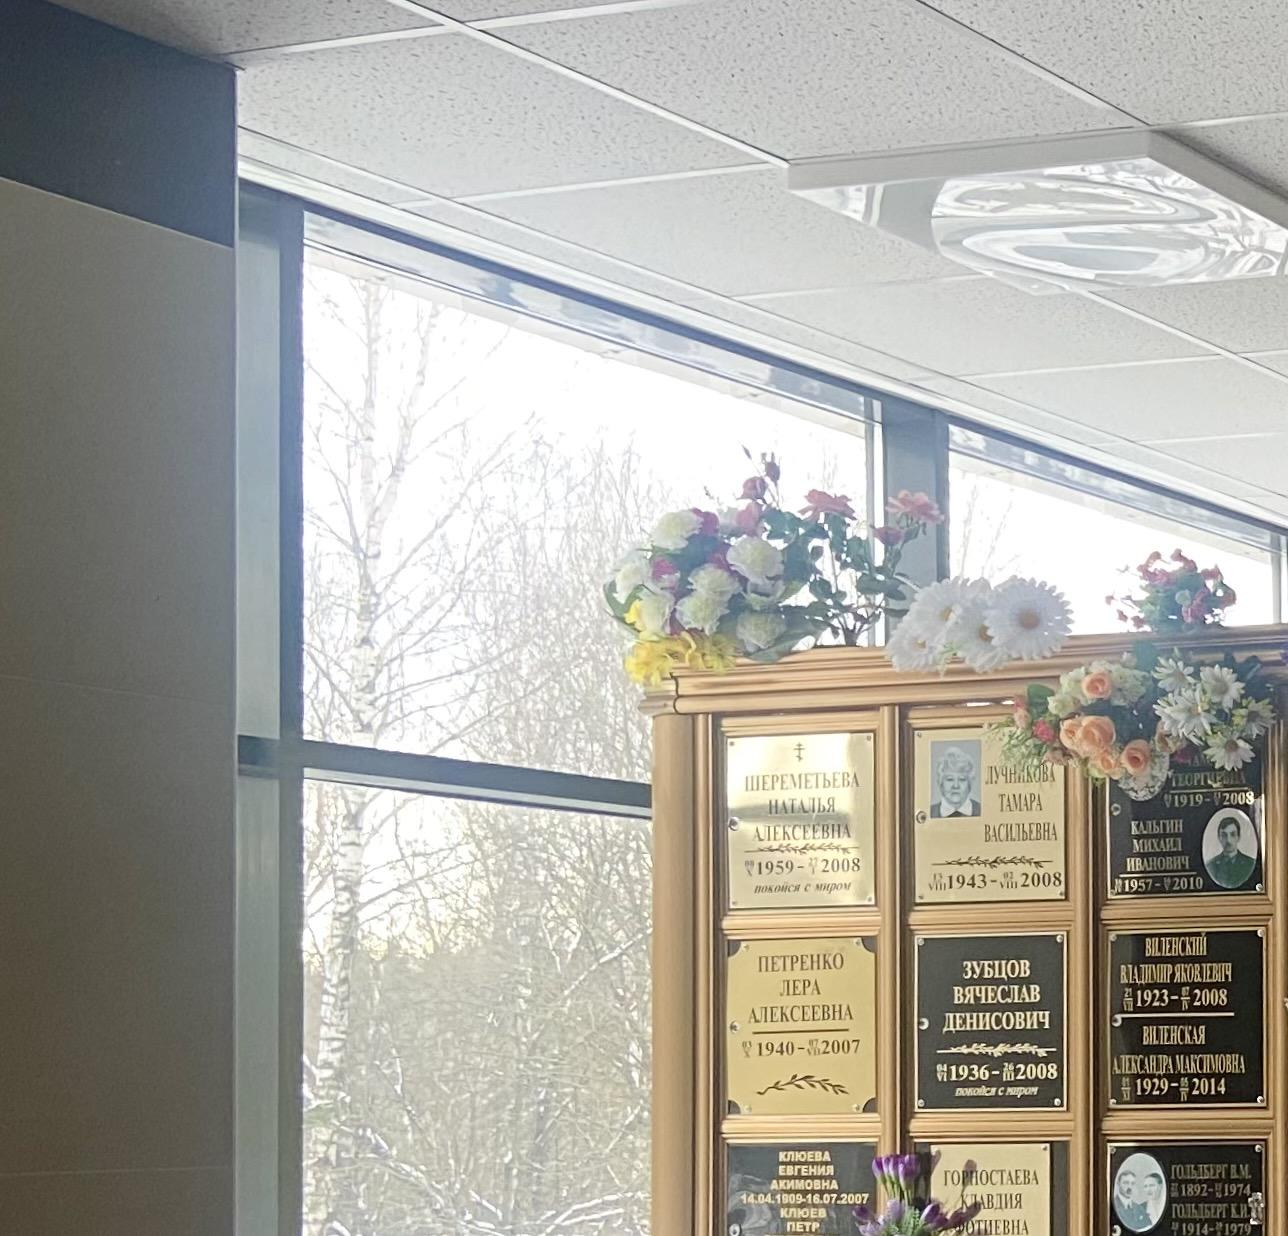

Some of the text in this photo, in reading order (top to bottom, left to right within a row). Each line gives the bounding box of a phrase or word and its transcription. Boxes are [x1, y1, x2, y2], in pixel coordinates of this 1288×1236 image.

[745, 771, 859, 791] ШЕРЕМЕТЬЕВА
[985, 764, 1056, 785] ЛУЧНИКОВА
[768, 797, 836, 815] НАТАЛЬЯ
[999, 793, 1042, 812] ТАМАРА
[1223, 791, 1255, 806] 2008
[753, 824, 851, 842] АЛЕКСЕЕВНА
[984, 823, 1057, 842] ВАСИЛЬЕВНА
[1131, 820, 1183, 835] КАЛЬГИН
[1133, 838, 1182, 853] МИХАИЛ
[757, 858, 860, 874] 1959 2008
[1126, 855, 1190, 871] ИВАНОВИЧ
[754, 881, 851, 894] покойся с миром
[947, 871, 1062, 890] 1943 2008
[1124, 876, 1203, 893] 1957 2010
[1145, 933, 1207, 957] ВИЛЕНСКИЙ
[758, 953, 844, 973] ПЕТРЕНКО
[963, 960, 1030, 981] ЗУБЦОВ
[1120, 963, 1232, 984] ВЛАДИМИР ЯКОВЛЕВИЧ
[780, 980, 820, 996] ЛЕРА
[953, 985, 1041, 1004] ВЯЧЕСЛАВ
[1136, 989, 1227, 1007] 1923 2008
[749, 1004, 853, 1024] АЛЕКСЕЕВНА
[943, 1011, 1050, 1033] ДЕНИСОВИЧ
[1143, 1025, 1206, 1045] ВИЛЕНСКАЯ
[757, 1039, 860, 1056] 1940 2007
[949, 1064, 1057, 1081] 1936 2008
[1113, 1054, 1246, 1075] АЛЕКСАНДРА МАКСИМОВНА
[956, 1086, 1004, 1097] покойся с
[1135, 1077, 1226, 1096] 1929 2014
[779, 1152, 831, 1161] КЛЮЕВА
[779, 1165, 834, 1176] ЕВГЕНИЯ
[944, 1169, 1039, 1186] ГОРНОСТАЕВА
[1171, 1164, 1227, 1181] ГОЛЬДБЕРГ
[771, 1179, 838, 1190] АКИМОВНА
[1181, 1183, 1251, 1198] 1892 1974
[961, 1194, 1022, 1210] КЛАВДИЯ
[780, 1207, 827, 1218] КЛЮЕВ
[1171, 1203, 1227, 1219] ГОЛЬДБЕРГ
[786, 1222, 820, 1232] ПЕТР
